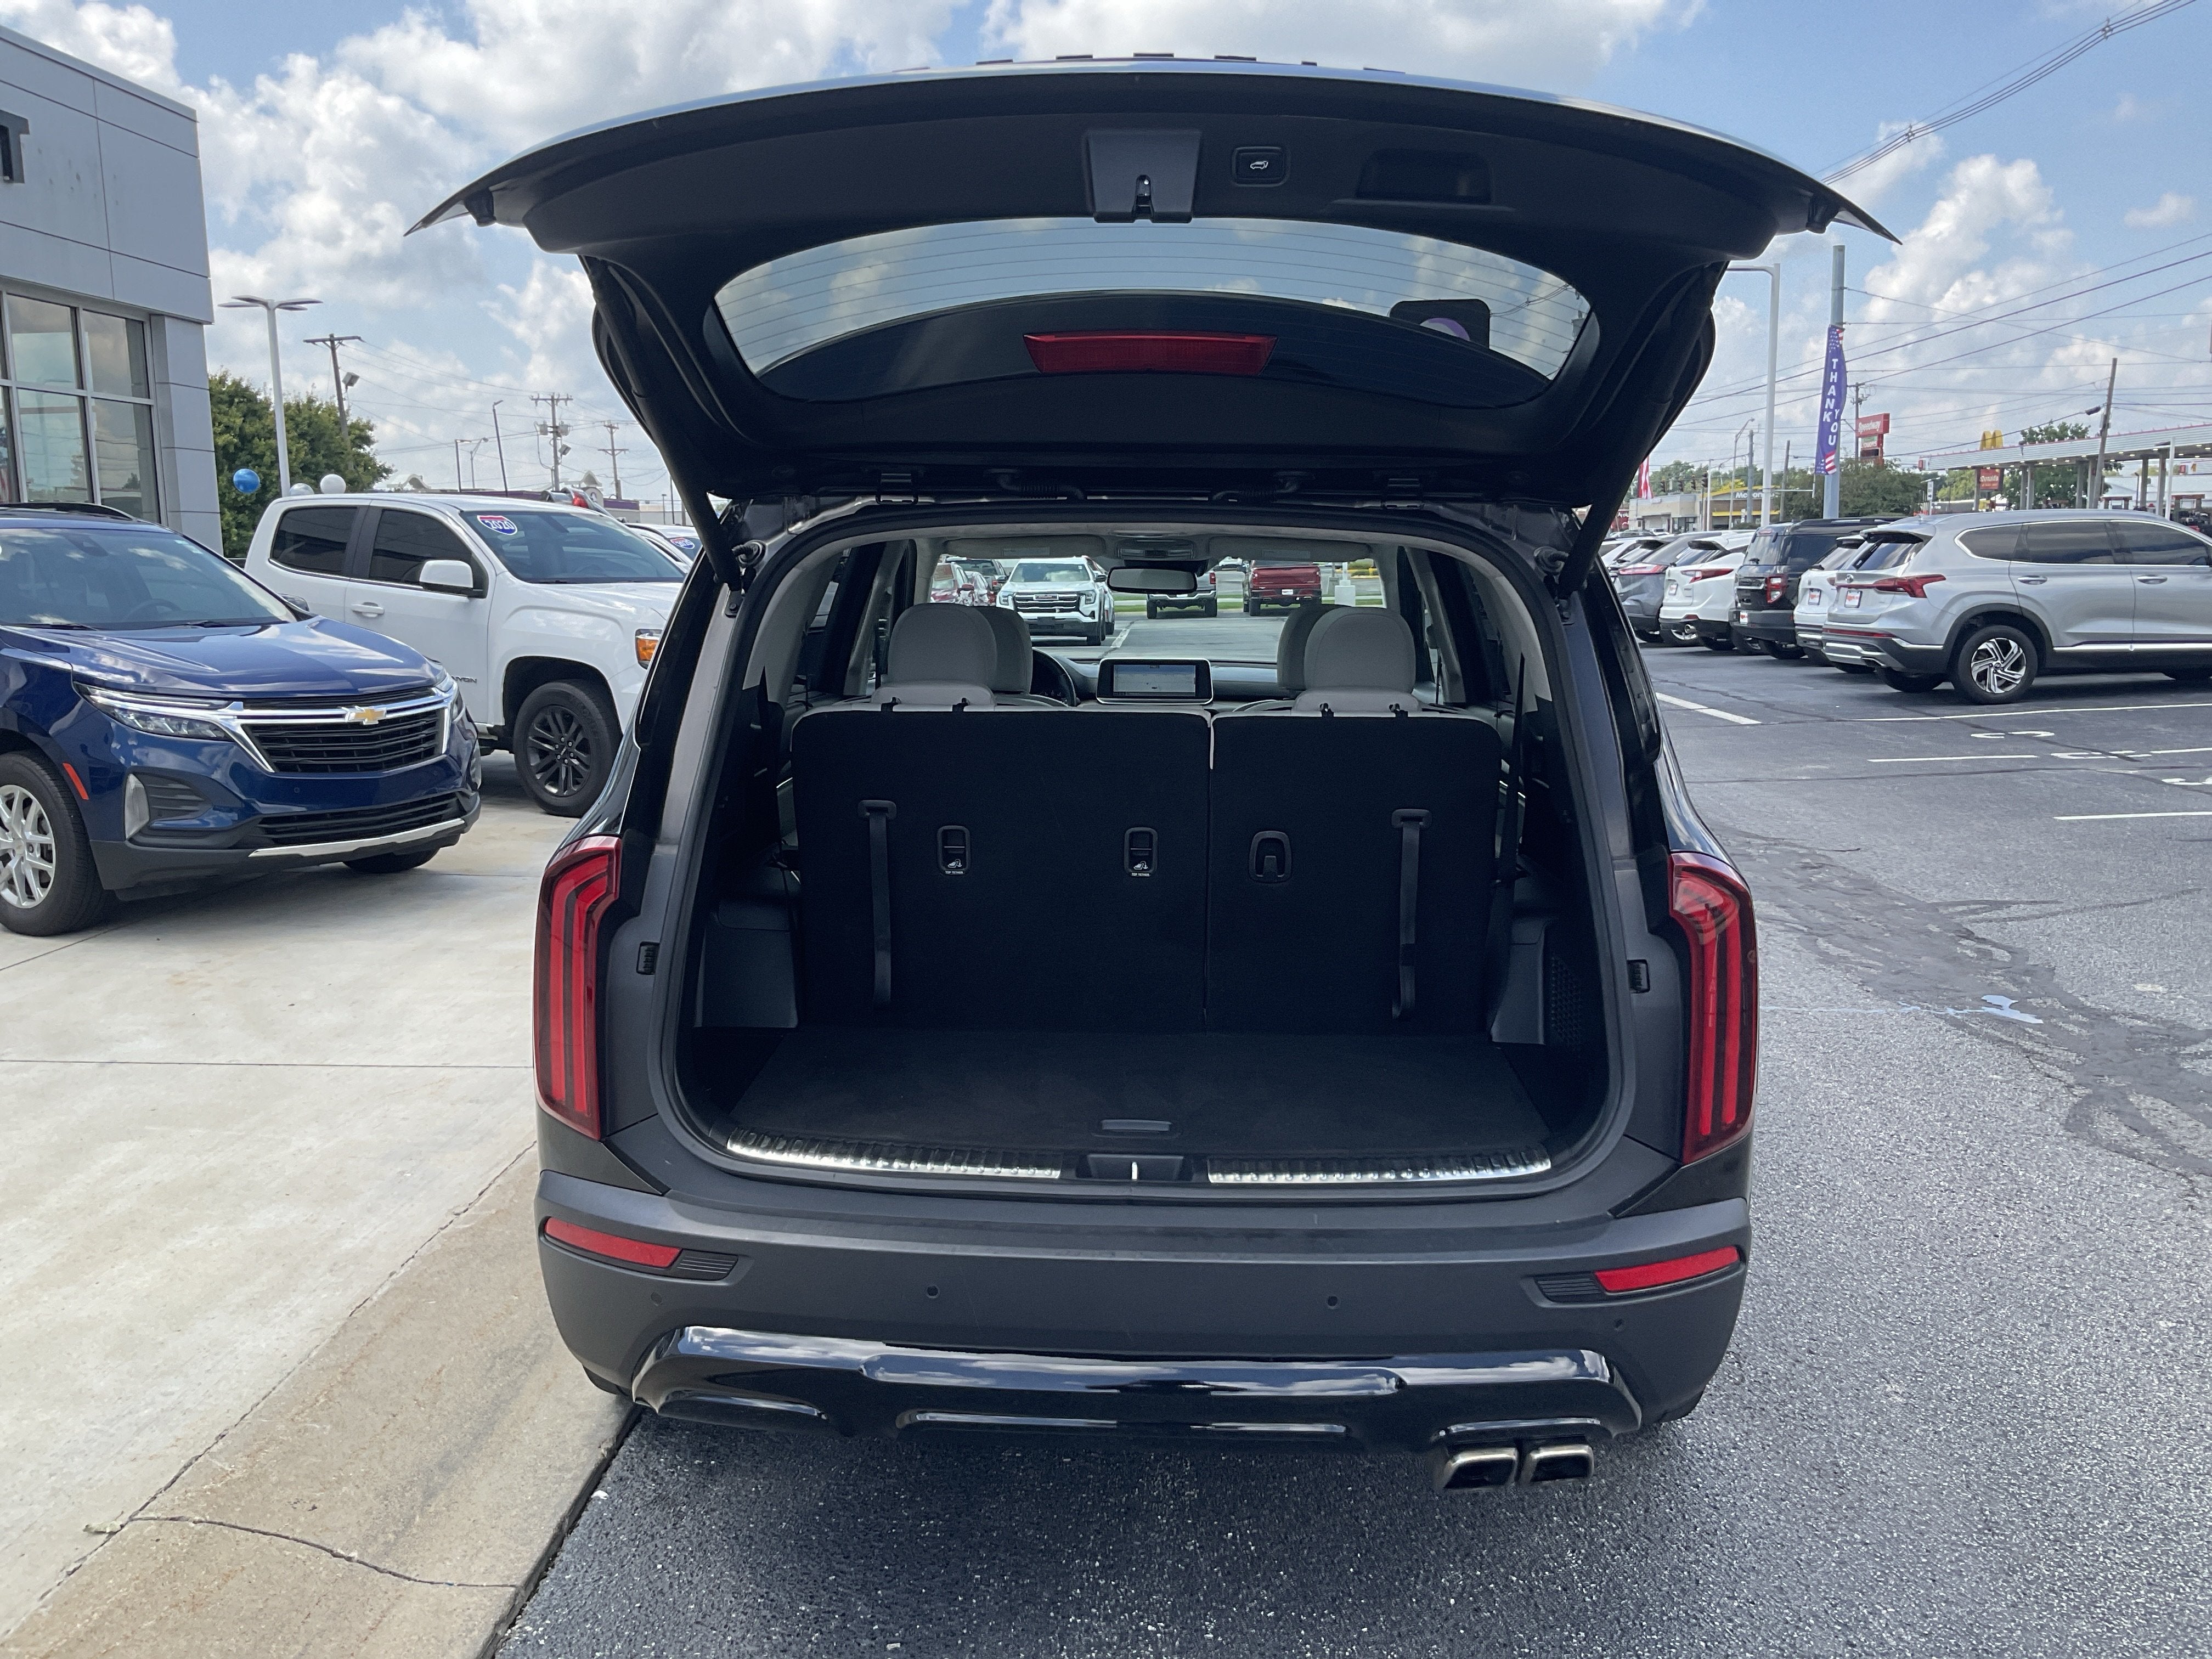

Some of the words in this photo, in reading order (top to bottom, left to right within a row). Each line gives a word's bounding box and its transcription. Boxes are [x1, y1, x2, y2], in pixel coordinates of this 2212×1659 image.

[1822, 358, 1838, 422] THANK
[1828, 409, 1840, 445] YOU
[1858, 421, 1881, 435] Speedway
[484, 520, 516, 529] 2020
